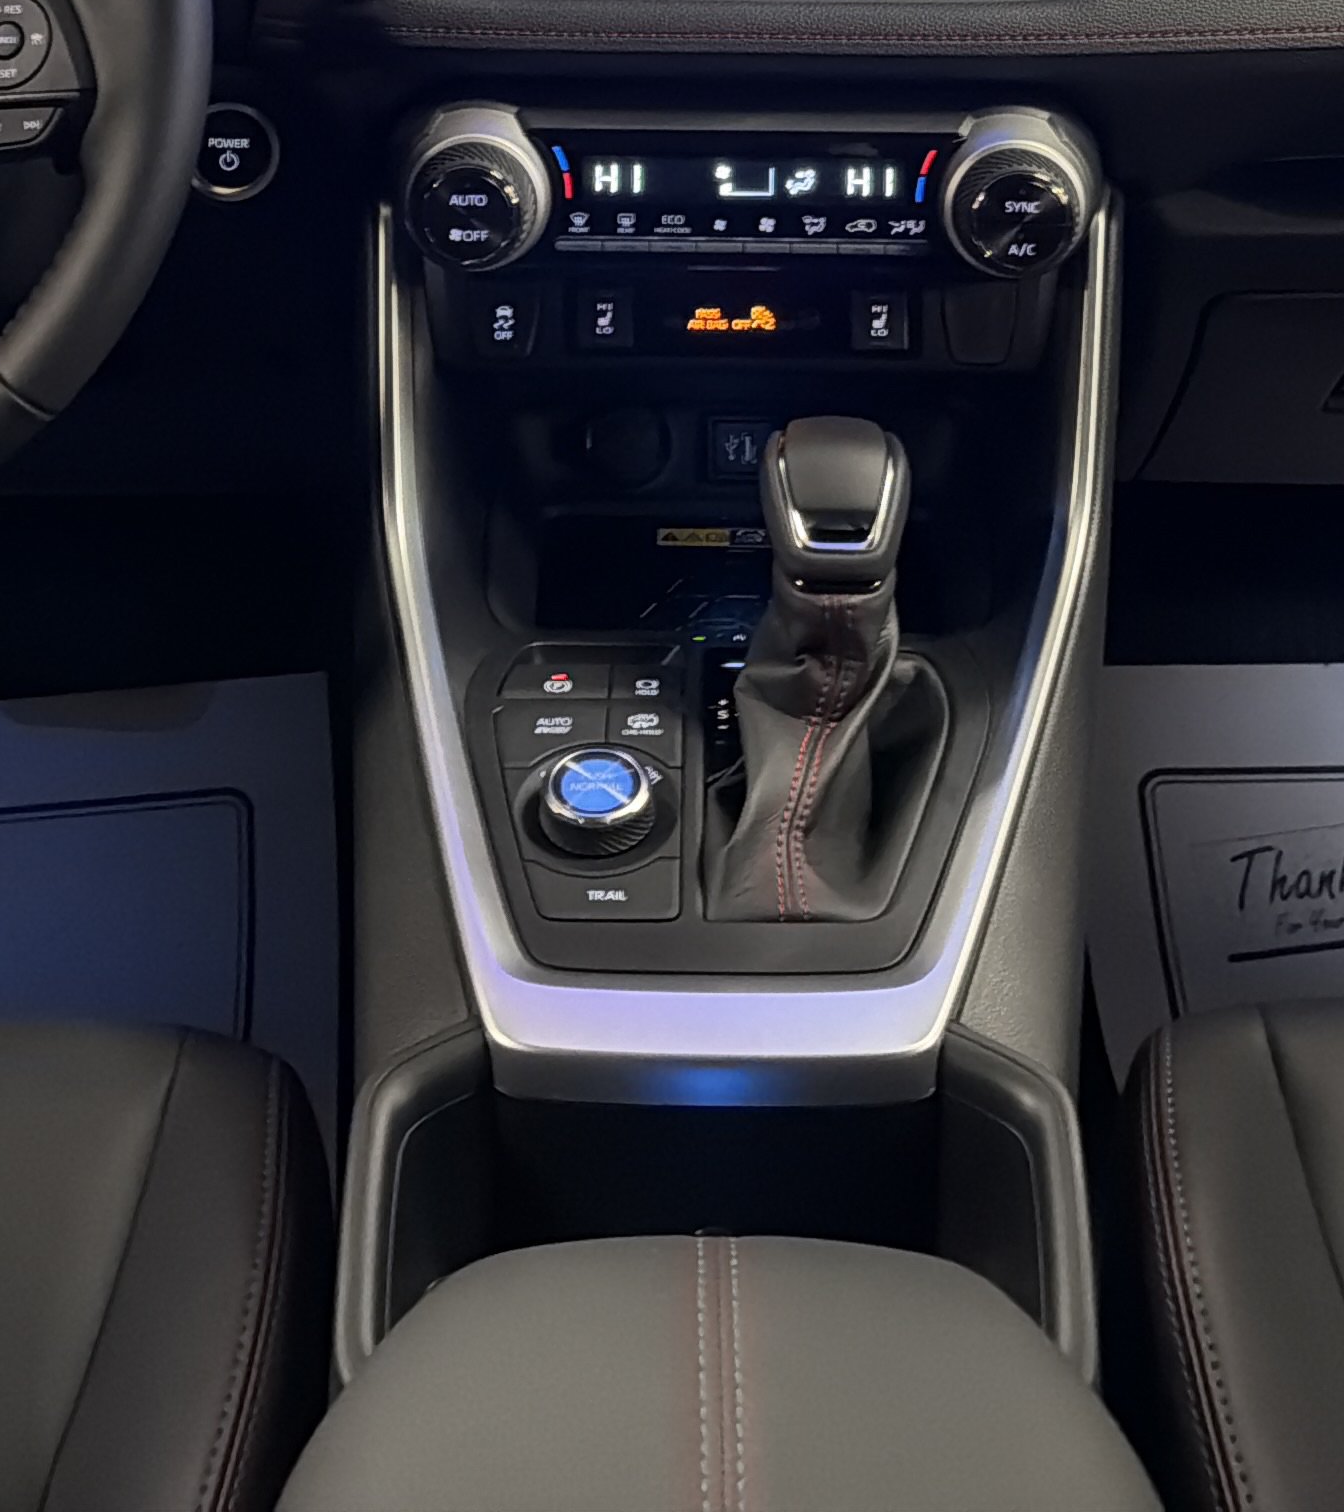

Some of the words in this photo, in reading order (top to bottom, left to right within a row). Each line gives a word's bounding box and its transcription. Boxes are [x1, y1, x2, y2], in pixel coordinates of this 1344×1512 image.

[4, 4, 24, 14] RES
[0, 68, 17, 79] SET
[207, 136, 251, 149] POWER
[593, 163, 643, 194] HI
[845, 167, 895, 197] HI
[448, 194, 489, 207] AUTO
[1004, 200, 1041, 215] SYNC
[661, 214, 686, 225] ECO
[462, 229, 491, 242] OFF
[1007, 242, 1037, 257] A/C
[494, 330, 514, 341] OFF
[635, 688, 659, 696] HOLD
[535, 716, 573, 727] AUTO
[586, 889, 628, 902] TRAIL
